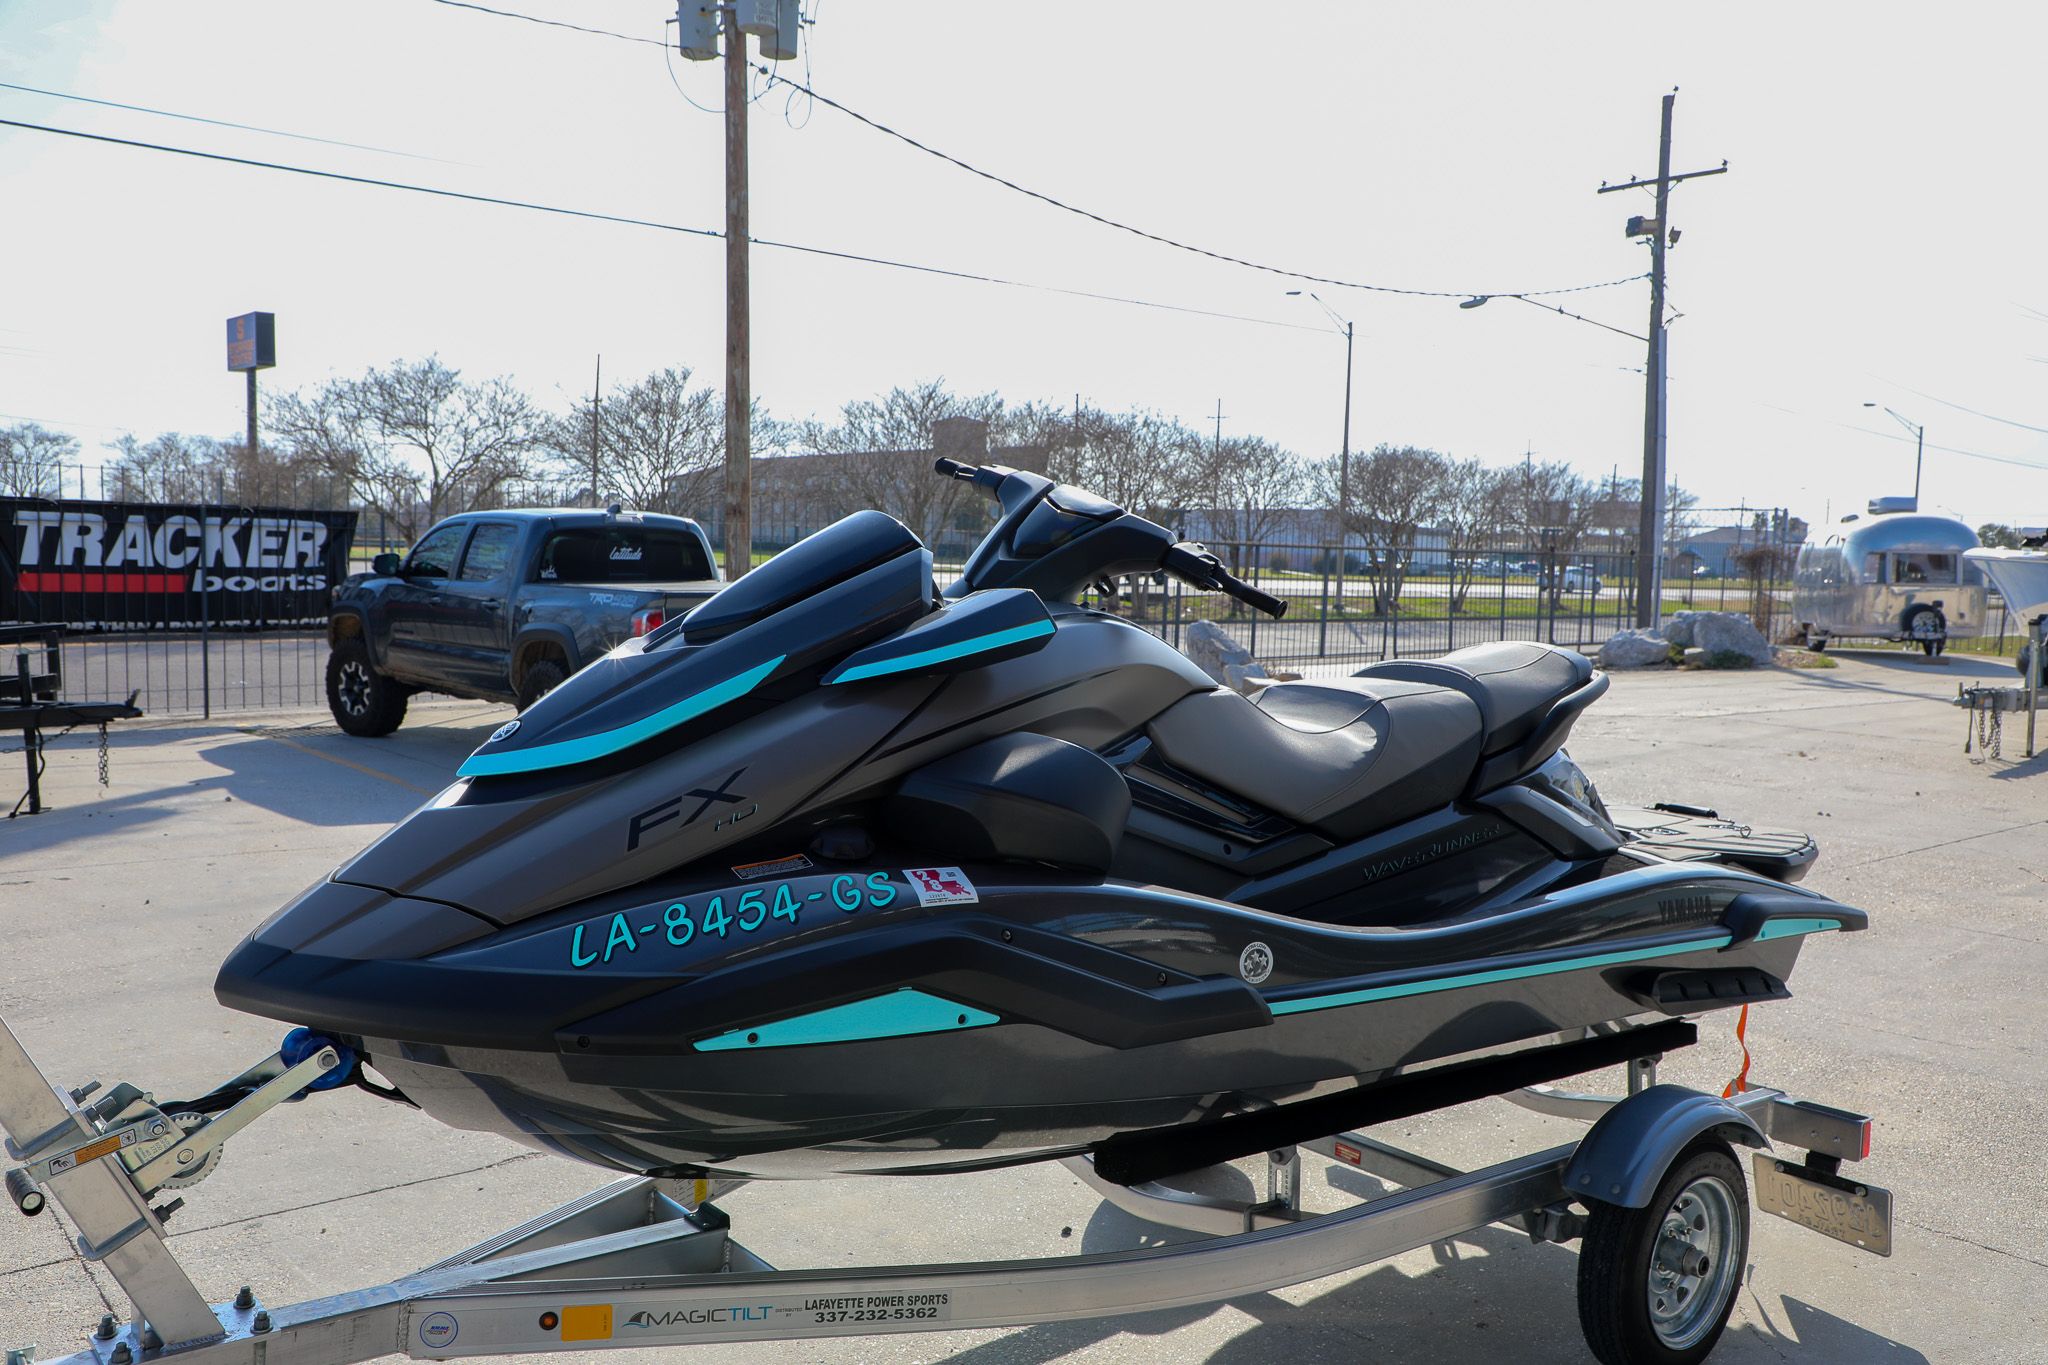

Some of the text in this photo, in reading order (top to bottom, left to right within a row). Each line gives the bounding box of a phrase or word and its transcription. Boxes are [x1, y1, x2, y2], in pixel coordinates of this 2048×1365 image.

[13, 510, 328, 568] TRACKER
[192, 568, 327, 592] boats
[626, 766, 749, 852] FX
[570, 871, 897, 968] LA-8454-GS
[1657, 895, 1713, 924] YAMAHA
[805, 1294, 948, 1310] LAFAYETTE POWER SPORTS
[814, 1307, 938, 1323] 337-232-5362
